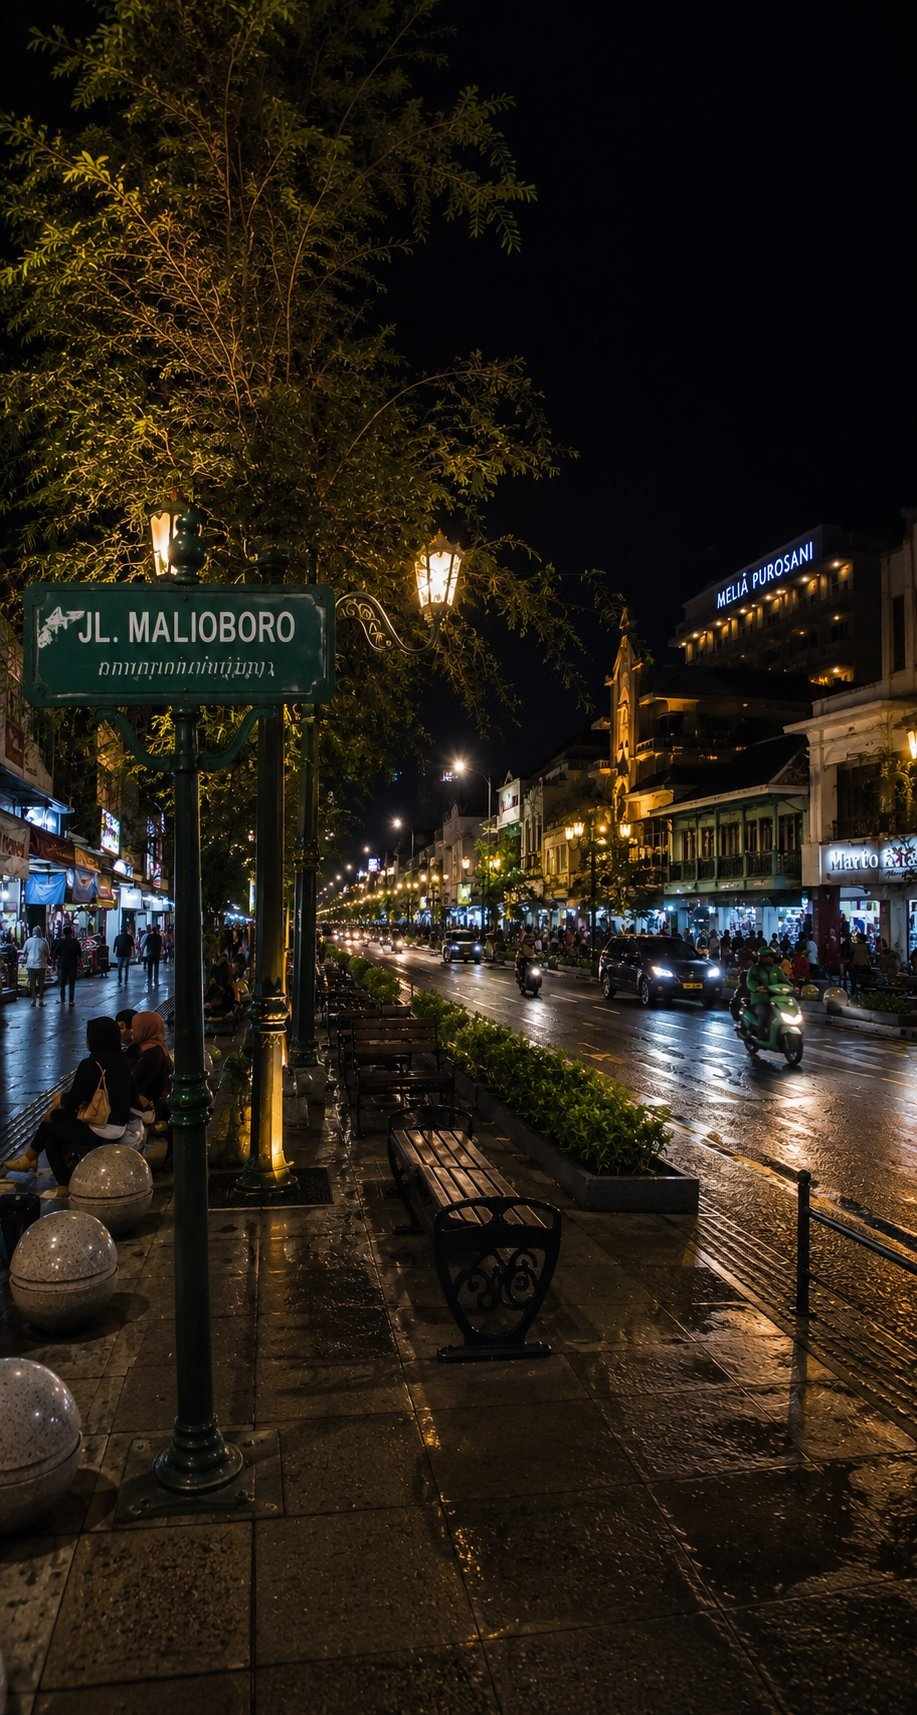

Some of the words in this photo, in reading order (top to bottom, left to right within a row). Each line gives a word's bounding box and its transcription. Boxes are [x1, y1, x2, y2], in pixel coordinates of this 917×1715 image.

[752, 541, 813, 589] PUROSANI
[78, 611, 119, 643] JL.
[128, 611, 295, 643] MALIOBORO
